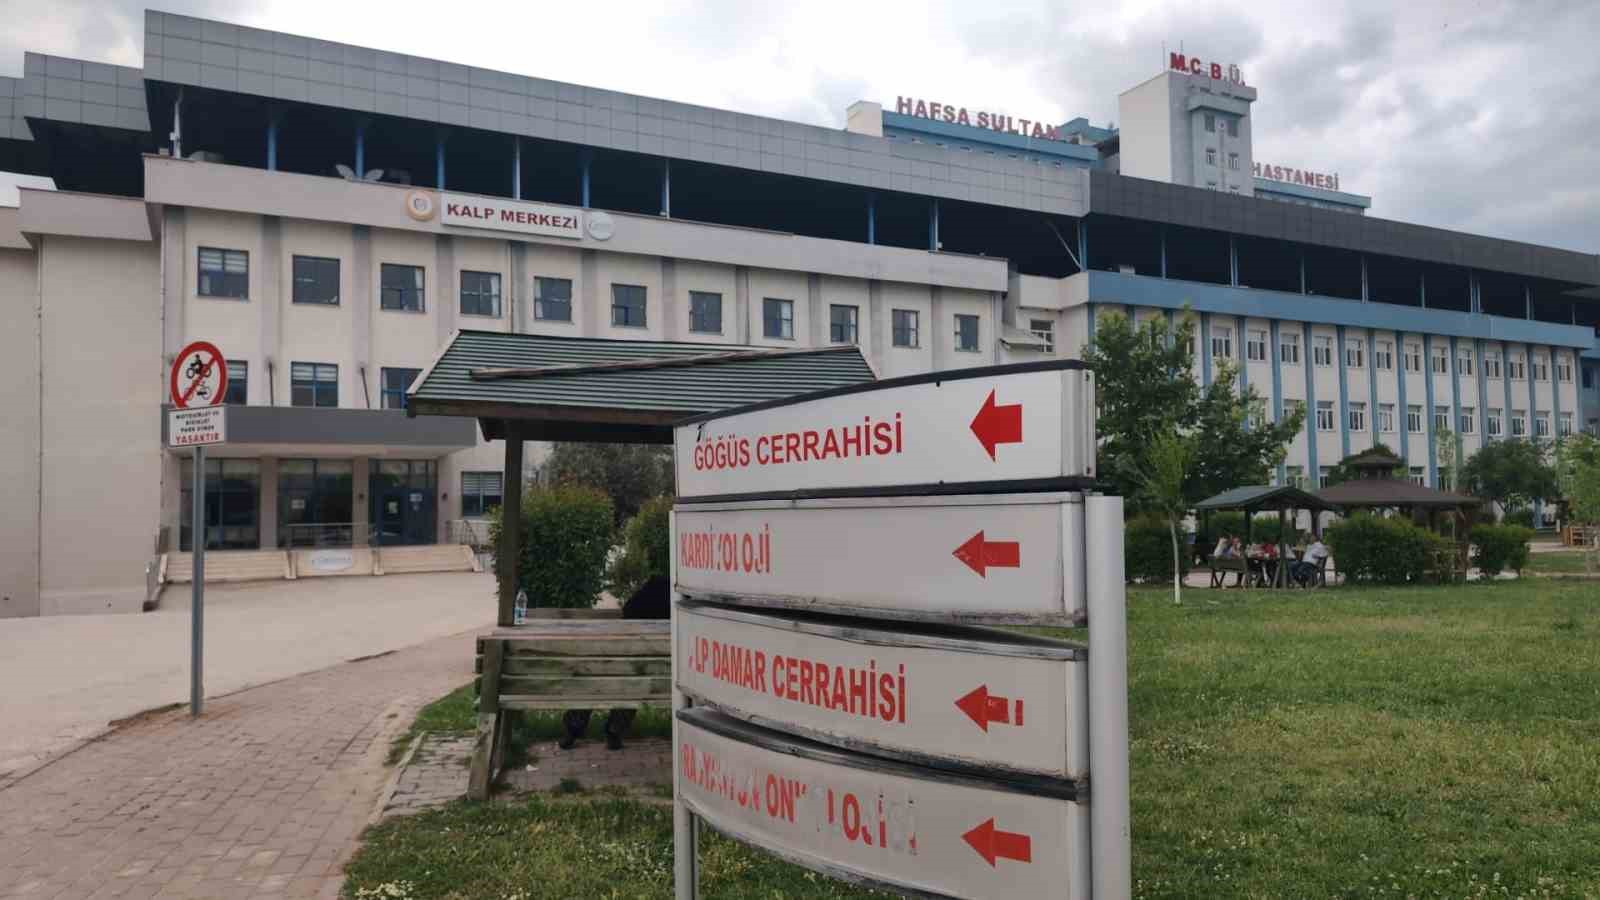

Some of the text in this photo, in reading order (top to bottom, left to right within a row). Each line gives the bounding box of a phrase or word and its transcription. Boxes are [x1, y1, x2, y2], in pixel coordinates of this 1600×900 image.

[896, 95, 1062, 142] HAFSA SULTAN
[1251, 161, 1340, 190] HASTANESİ
[447, 203, 578, 229] KALP MERKEZİ
[176, 433, 219, 443] YASAKTIR
[694, 411, 903, 471] GÖĞÜS CERRAHİSİ
[712, 640, 767, 692] DAMAR
[771, 655, 905, 723] CERRAHİSİ
